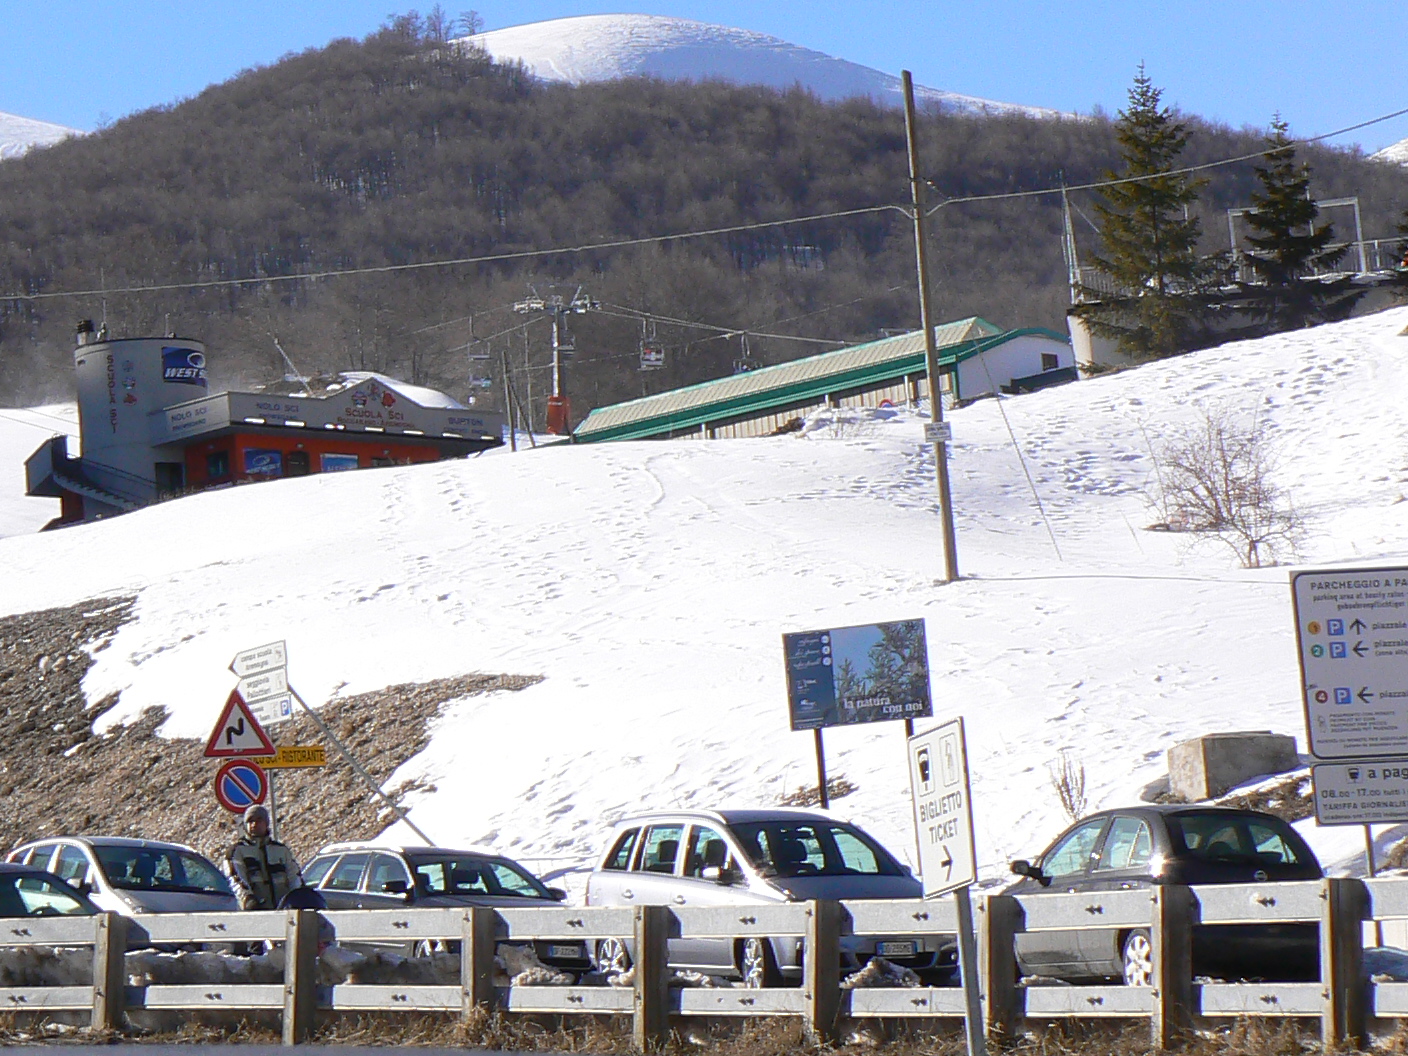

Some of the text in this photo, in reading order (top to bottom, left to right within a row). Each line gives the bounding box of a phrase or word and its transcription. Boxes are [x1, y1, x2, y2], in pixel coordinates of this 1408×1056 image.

[165, 367, 197, 378] WEST
[195, 407, 207, 417] SCI
[256, 402, 299, 413] NOLO SCI
[345, 408, 404, 420] SCUOLA SCI
[1310, 579, 1380, 590] PARCHEGGIO
[1384, 579, 1391, 587] A
[1372, 621, 1407, 631] piazzale
[843, 697, 891, 709] la natura
[882, 700, 923, 713] con noi
[282, 750, 325, 763] RISTORANTE
[1368, 769, 1376, 778] a
[920, 790, 961, 822] BIGLIETTO
[1323, 802, 1358, 811] TARIFFA
[929, 817, 958, 844] TICKET
